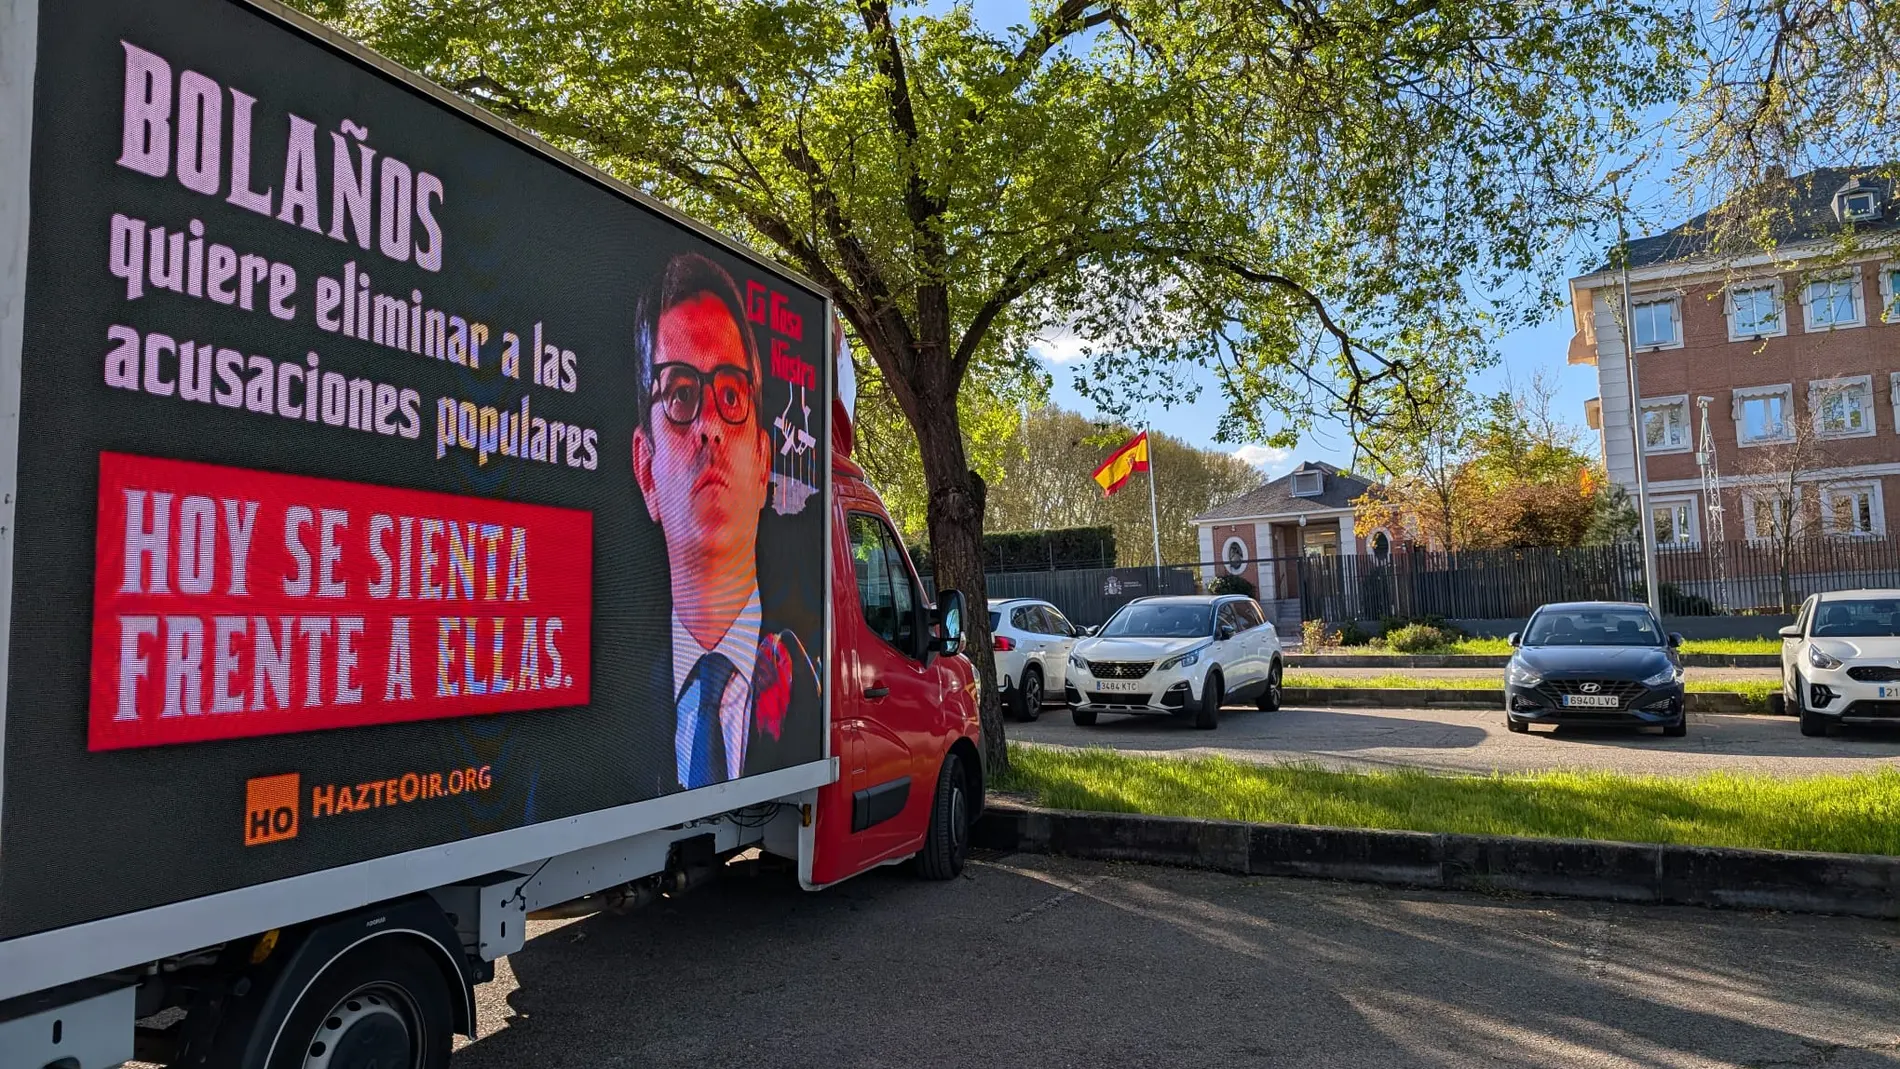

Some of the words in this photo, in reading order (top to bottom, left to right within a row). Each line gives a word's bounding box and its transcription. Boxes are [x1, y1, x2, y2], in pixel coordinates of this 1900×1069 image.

[116, 39, 444, 273] BOLAÑOS
[109, 213, 296, 320] quiere
[316, 260, 488, 370] eliminar
[501, 332, 520, 378] a
[533, 322, 578, 393] las
[104, 324, 421, 439] acusaciones
[436, 395, 599, 471] populares
[119, 488, 259, 596] HOY
[282, 506, 349, 598] SE
[367, 513, 530, 602] SIENTA
[113, 614, 364, 721] FRENTE
[383, 616, 415, 701] A
[436, 616, 573, 698] ELLAS.
[1121, 682, 1137, 691] KTC
[1570, 696, 1596, 705] 6940
[1597, 697, 1617, 706] LVC
[250, 806, 294, 839] HO
